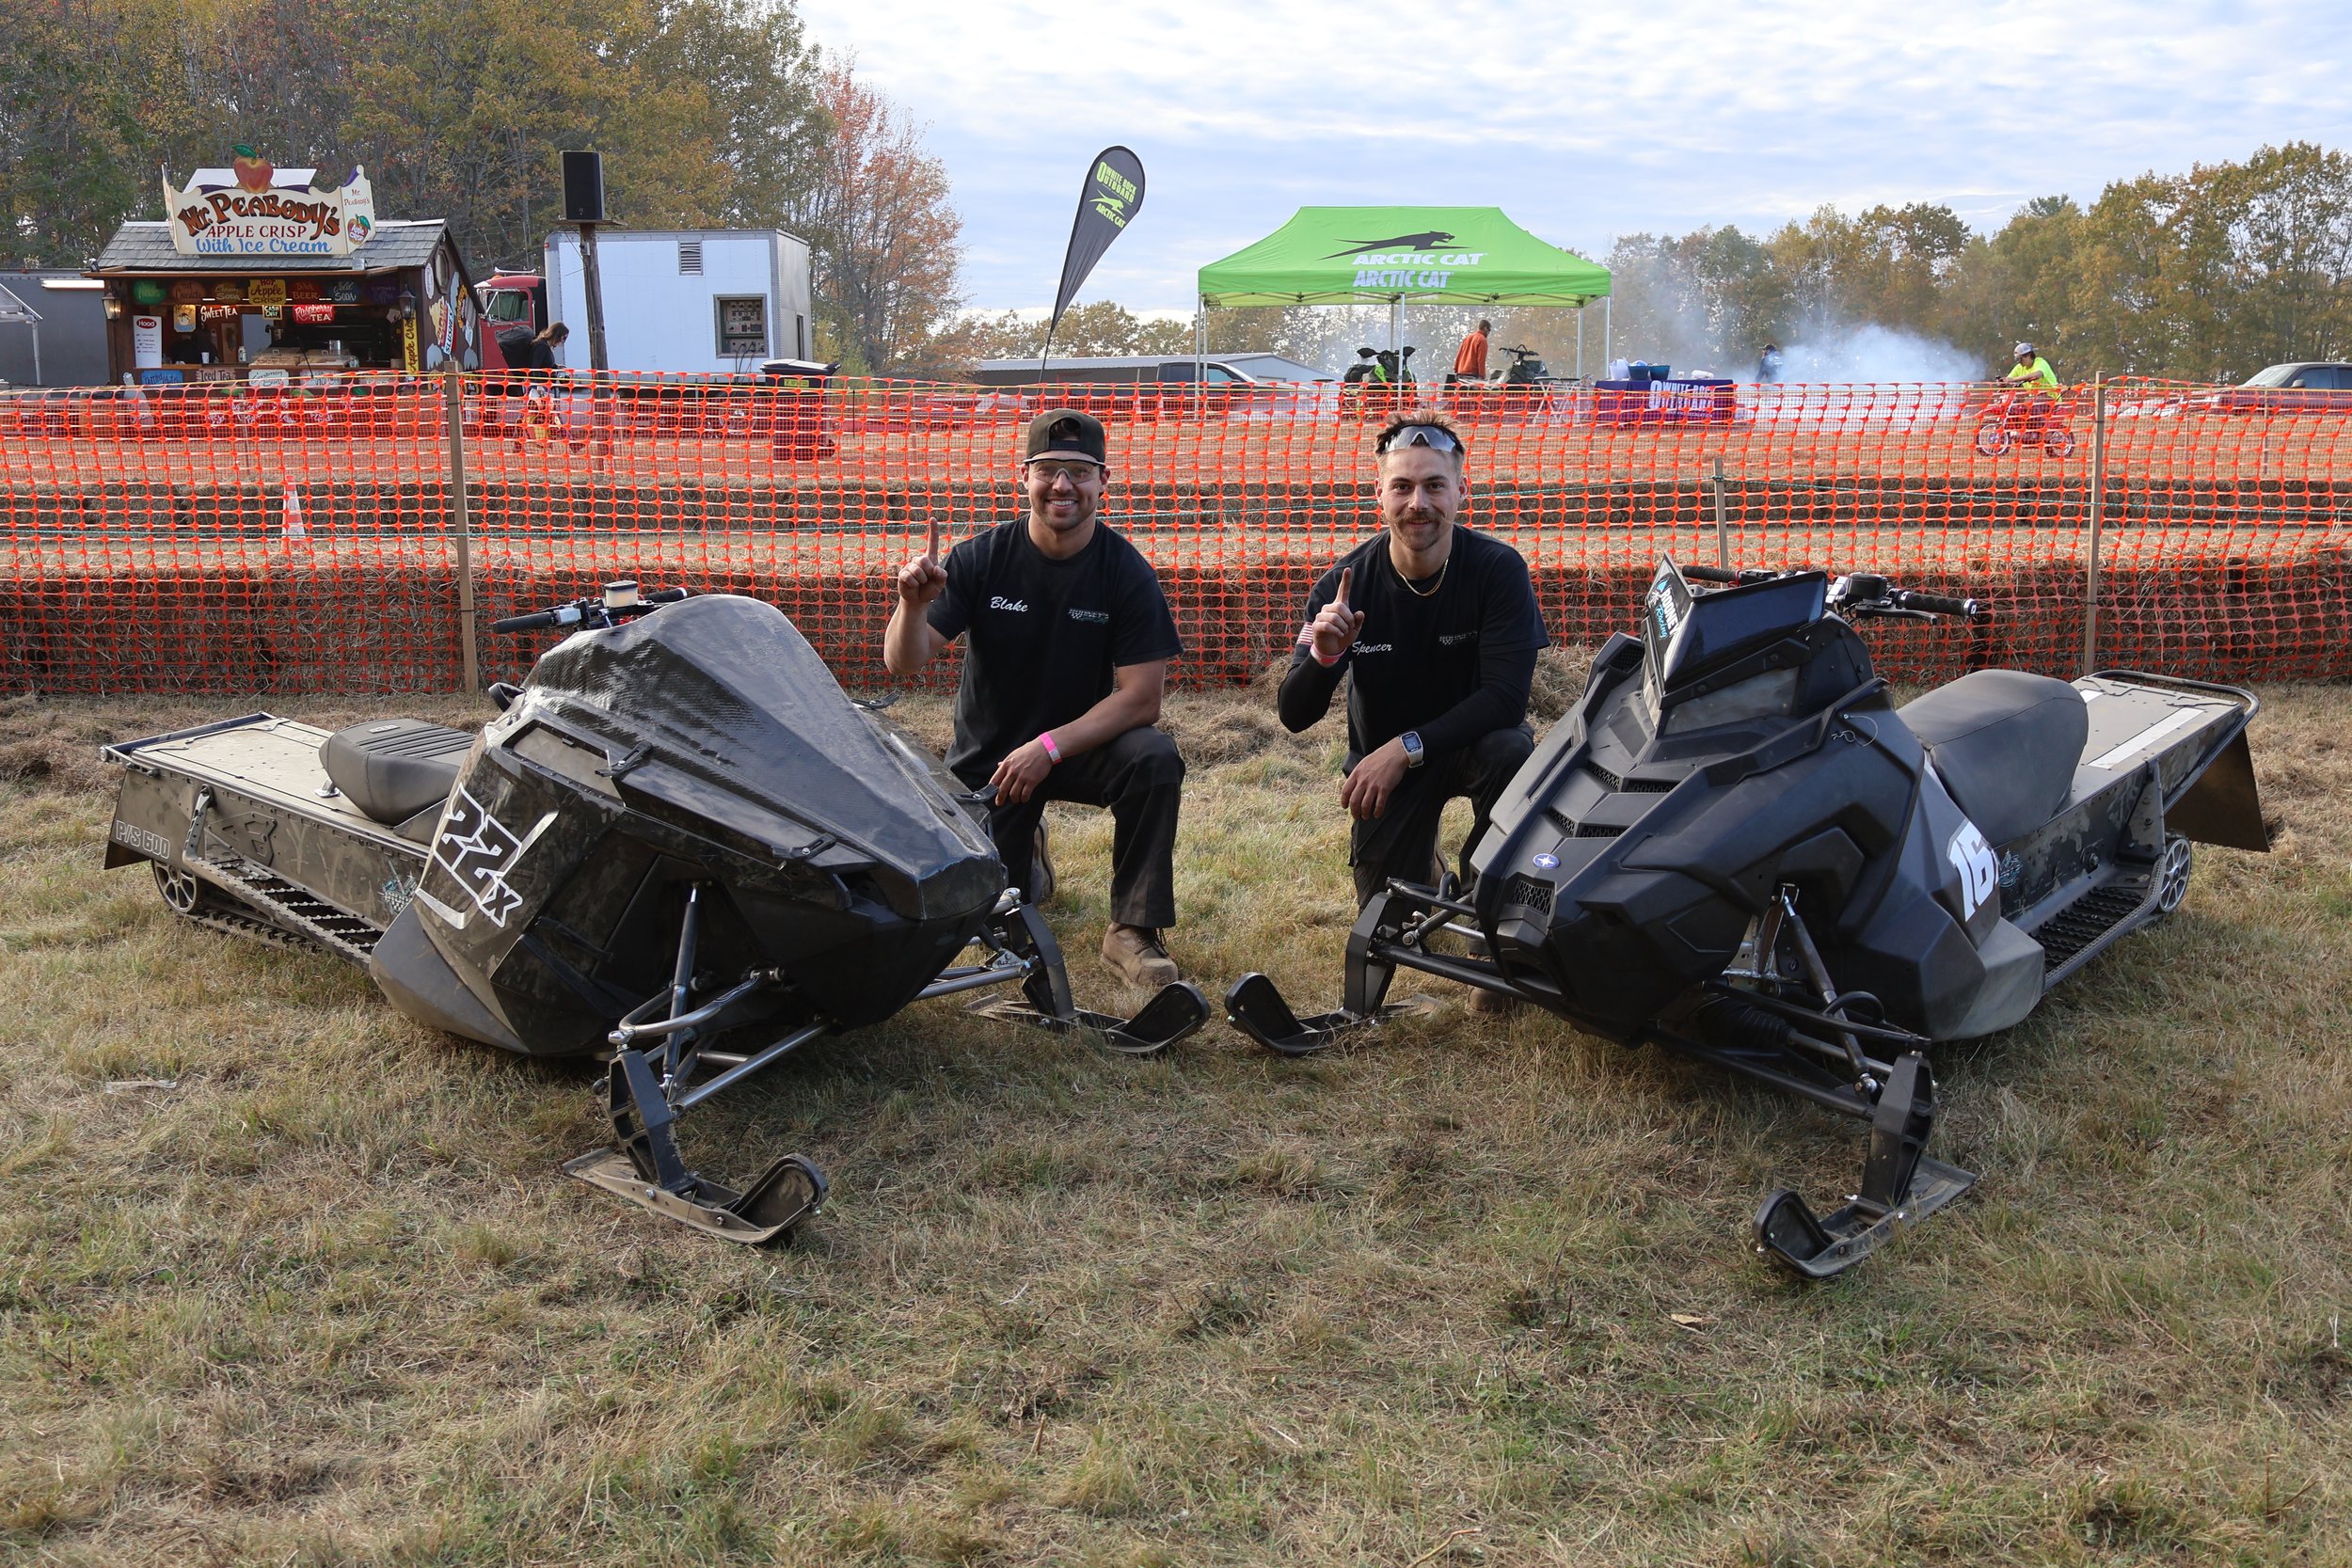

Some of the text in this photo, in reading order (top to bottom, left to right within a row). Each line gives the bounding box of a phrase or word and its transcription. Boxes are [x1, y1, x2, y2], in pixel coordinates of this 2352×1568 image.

[177, 205, 214, 237] Mr.
[1095, 202, 1127, 229] ARCTIC CAT
[205, 225, 308, 238] APPLE CRISP
[196, 238, 332, 253] With Ice Cream
[1352, 253, 1484, 265] ARCTIC CAT
[1352, 270, 1452, 288] ARCTIC CAT
[250, 284, 283, 299] Apple
[310, 313, 332, 322] TEA
[405, 341, 418, 373] Apple
[199, 369, 231, 382] Iced Tea
[991, 596, 1028, 612] Blake
[1352, 641, 1392, 656] Spencer
[116, 819, 170, 860] P/S 600
